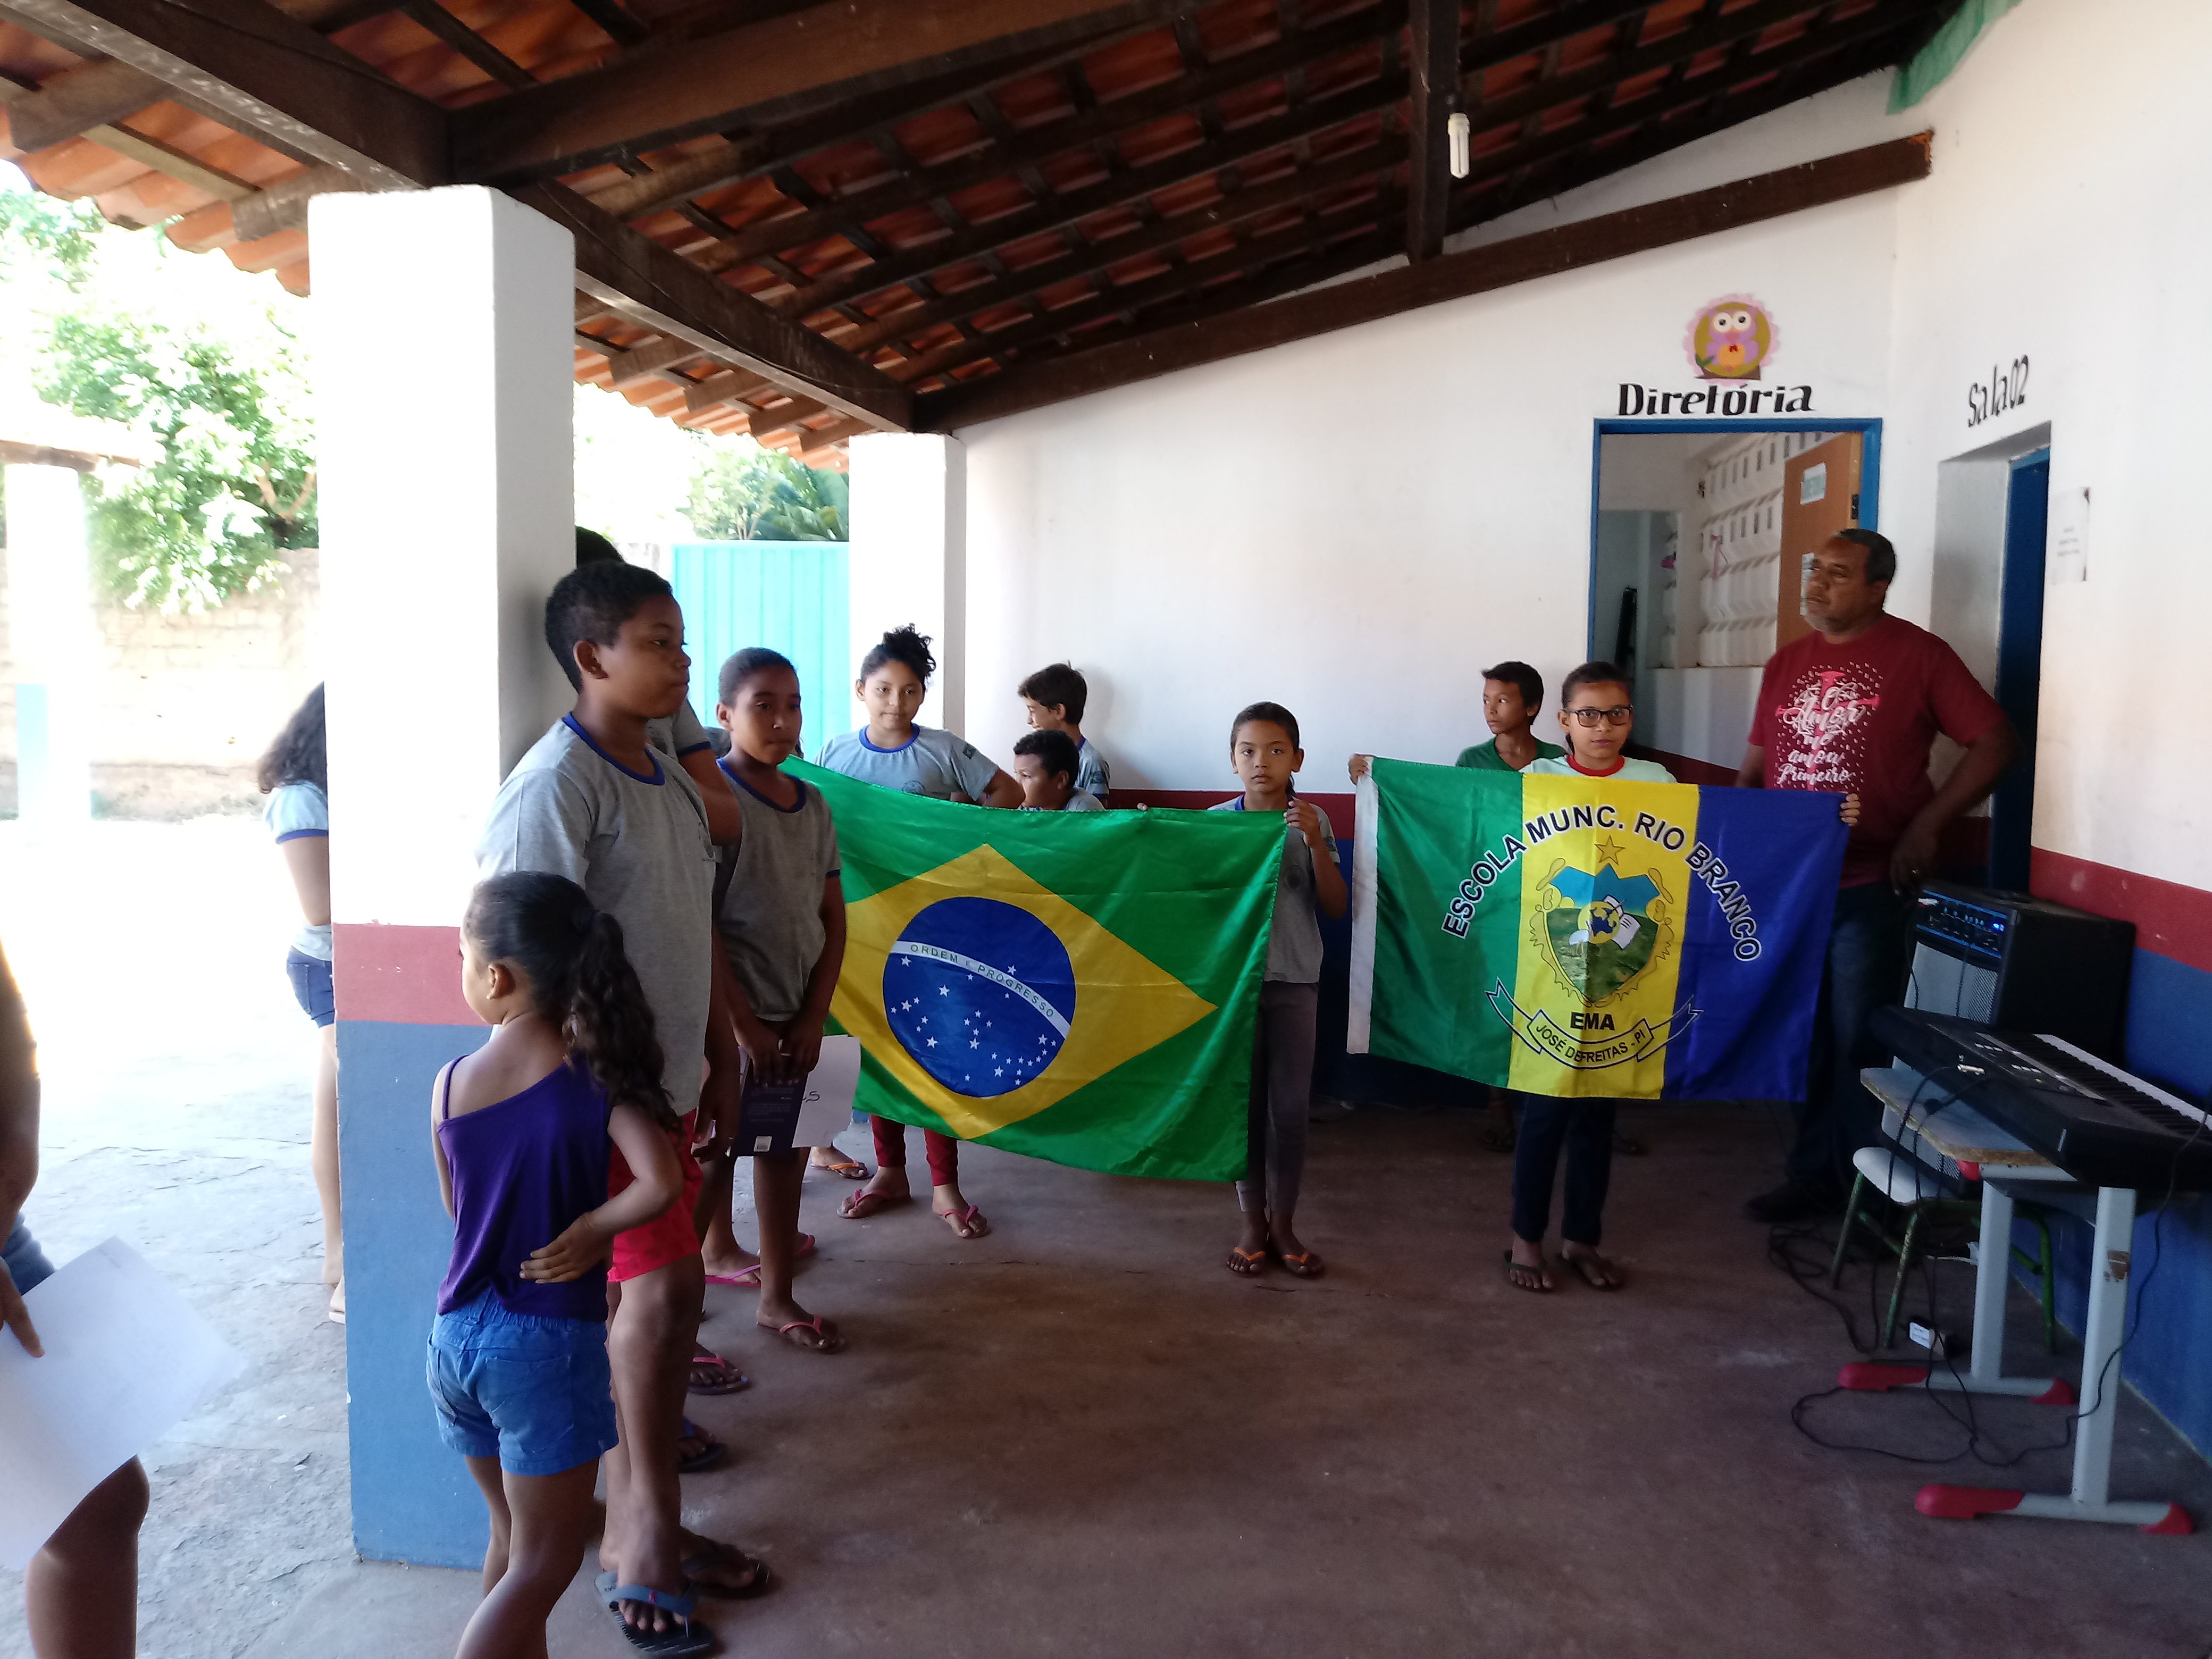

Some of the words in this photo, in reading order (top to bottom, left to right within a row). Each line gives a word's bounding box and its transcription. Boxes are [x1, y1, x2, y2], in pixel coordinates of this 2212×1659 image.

[1618, 382, 1815, 416] Diretória
[1440, 834, 1527, 939] ESCOLA
[1524, 805, 1624, 844] MUNC.
[1634, 810, 1686, 851] RIO
[1684, 840, 1762, 962] BRANCO
[910, 944, 958, 963] ORDEM
[977, 965, 1054, 1018] PROGRESSO
[1570, 1011, 1615, 1031] EMA
[1536, 1025, 1567, 1053] JOSÉ
